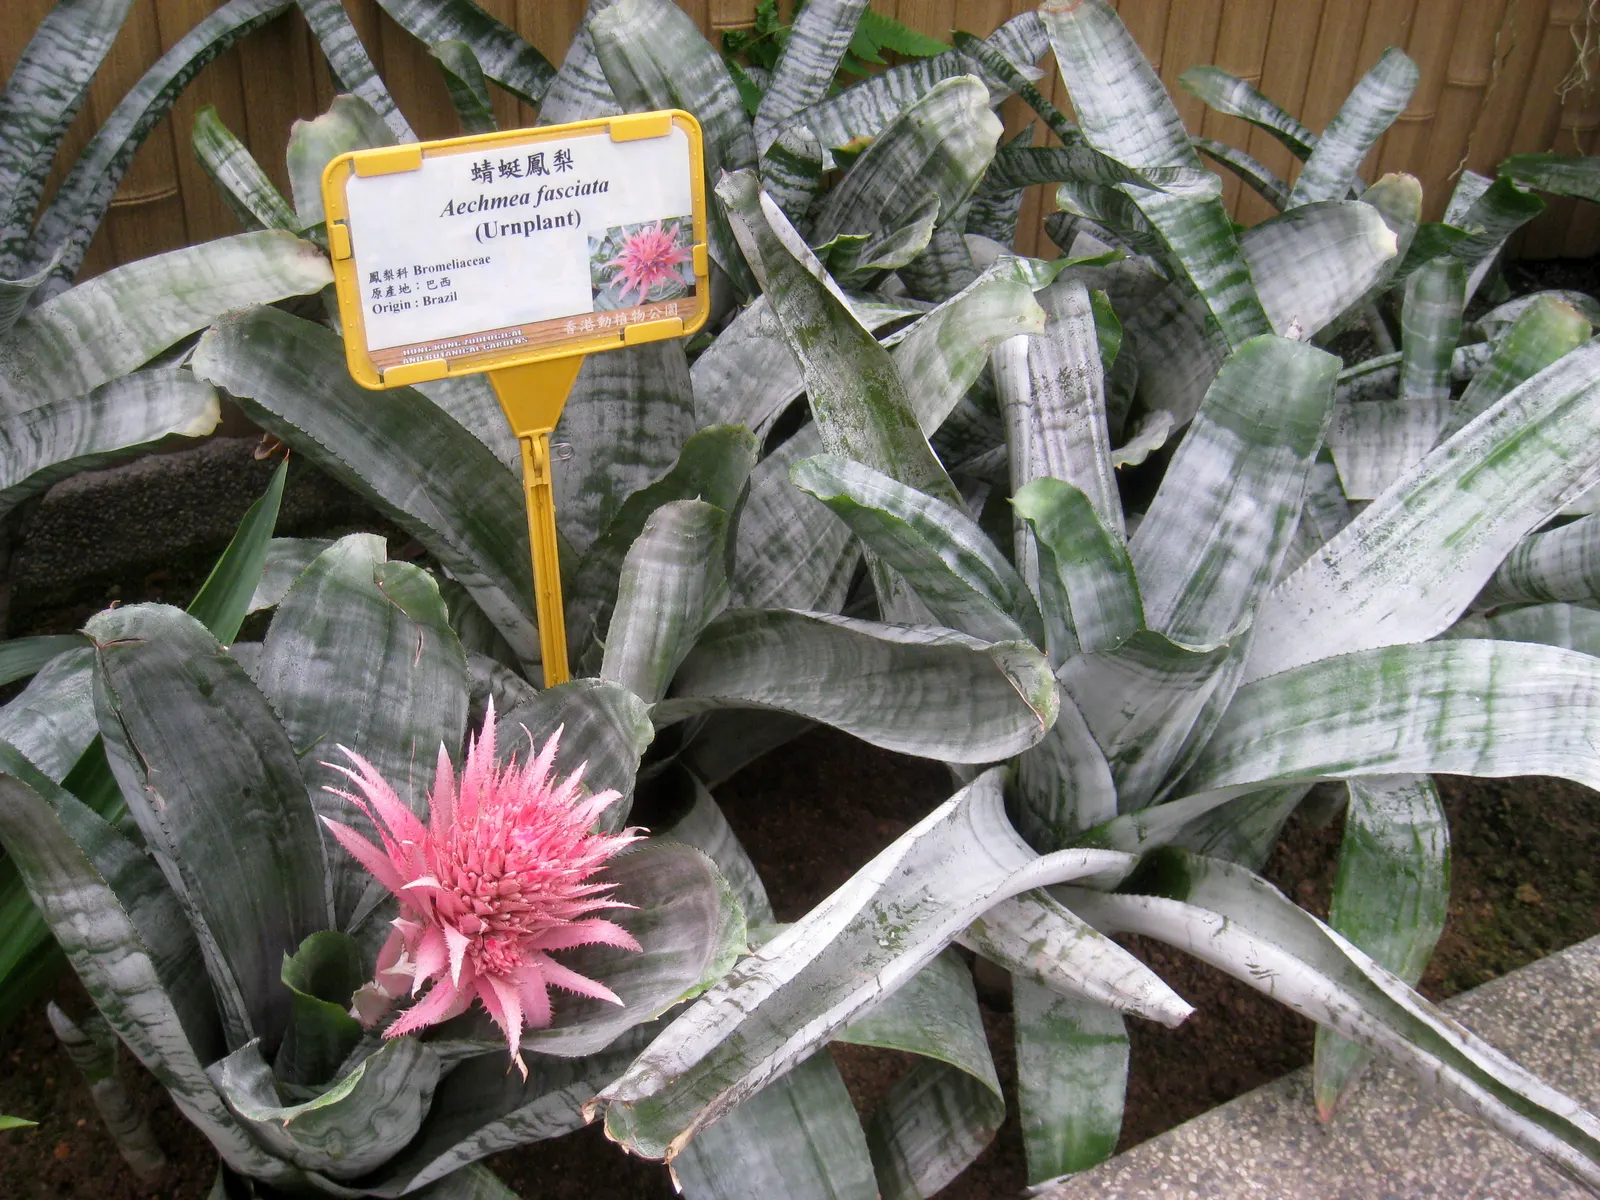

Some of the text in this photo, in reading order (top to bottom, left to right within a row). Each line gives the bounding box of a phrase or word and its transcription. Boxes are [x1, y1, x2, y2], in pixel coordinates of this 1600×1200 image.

[470, 148, 574, 184] 蜻蜓鳳梨
[439, 178, 609, 218] Aechmea fasciata
[475, 208, 582, 244] (Urnplant)
[369, 255, 491, 285] 鳳梨科 Bromeliaceae
[372, 300, 411, 315] Origin
[422, 291, 458, 306] Brazil
[563, 302, 678, 335] 香港動植物公園
[402, 329, 523, 356] HONG KONG ZOOLOGICAL
[483, 336, 528, 350] GARDENS
